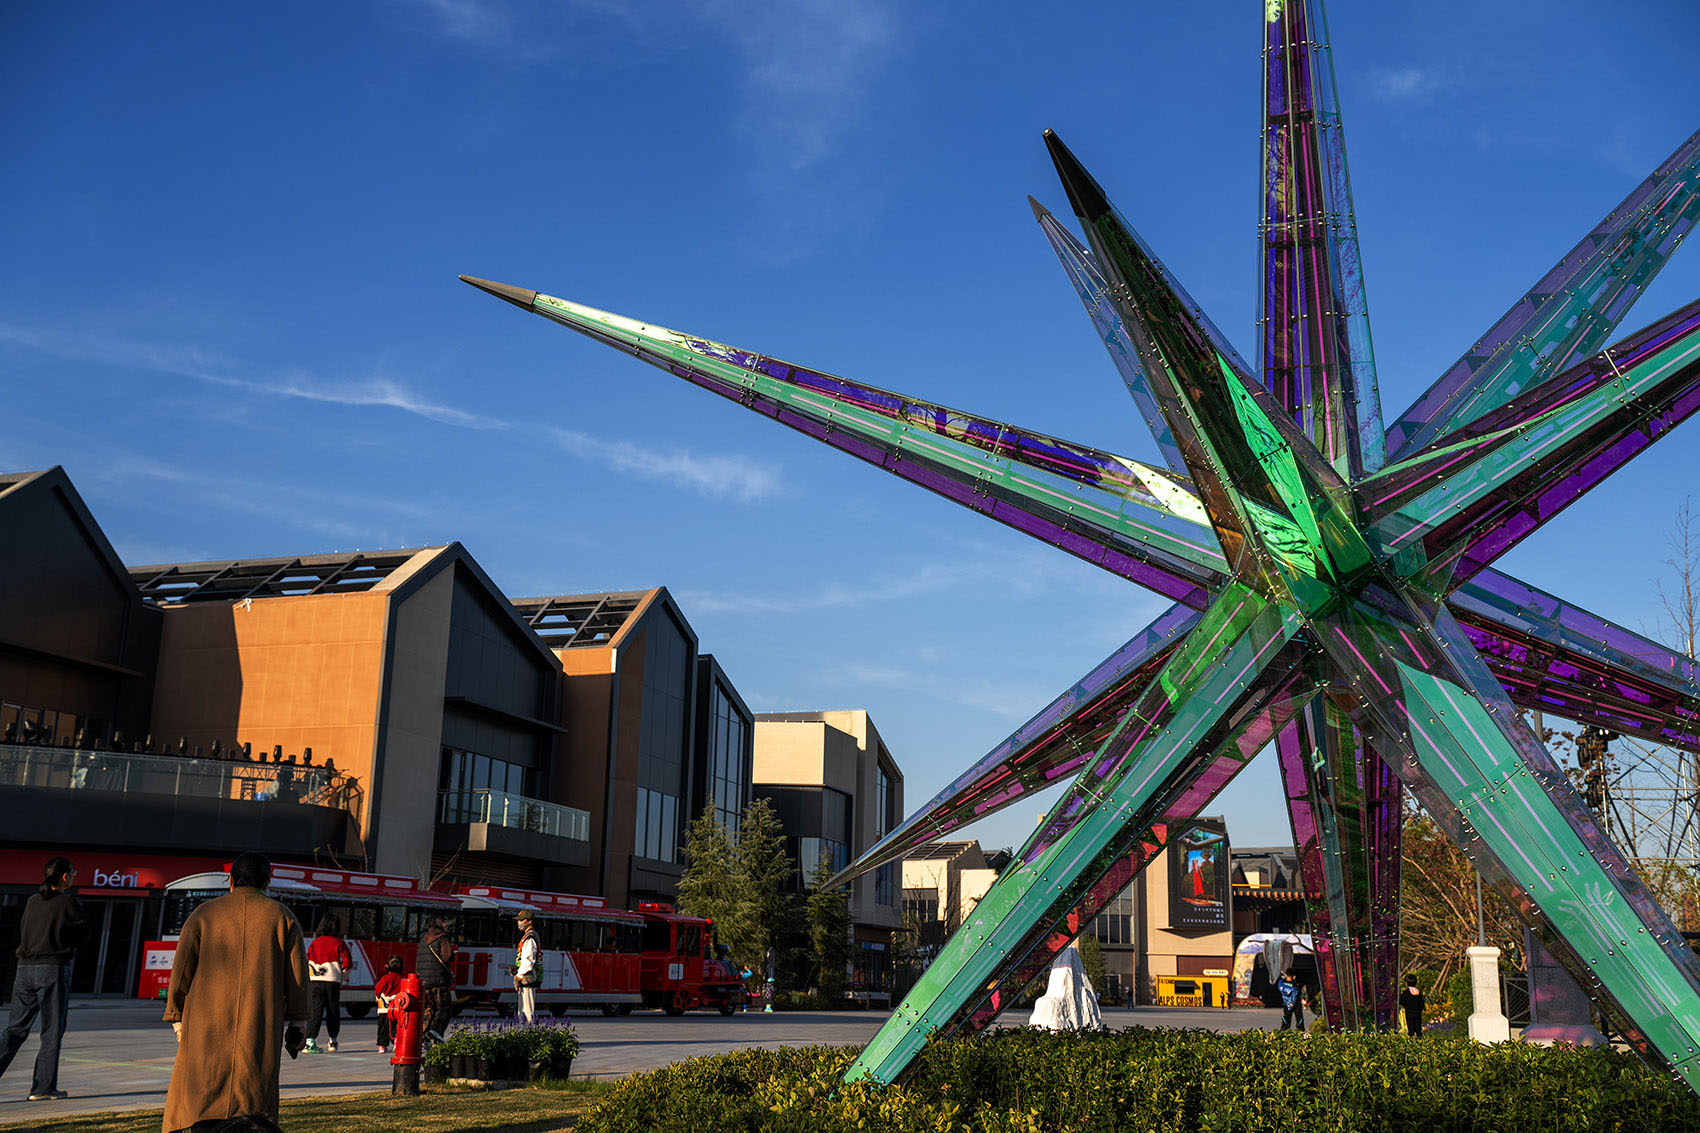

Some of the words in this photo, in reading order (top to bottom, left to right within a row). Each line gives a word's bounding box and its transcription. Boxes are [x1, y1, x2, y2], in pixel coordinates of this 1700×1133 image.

[93, 868, 139, 888] béni
[1159, 995, 1175, 1006] ALPS
[1176, 995, 1203, 1007] COSMOS
